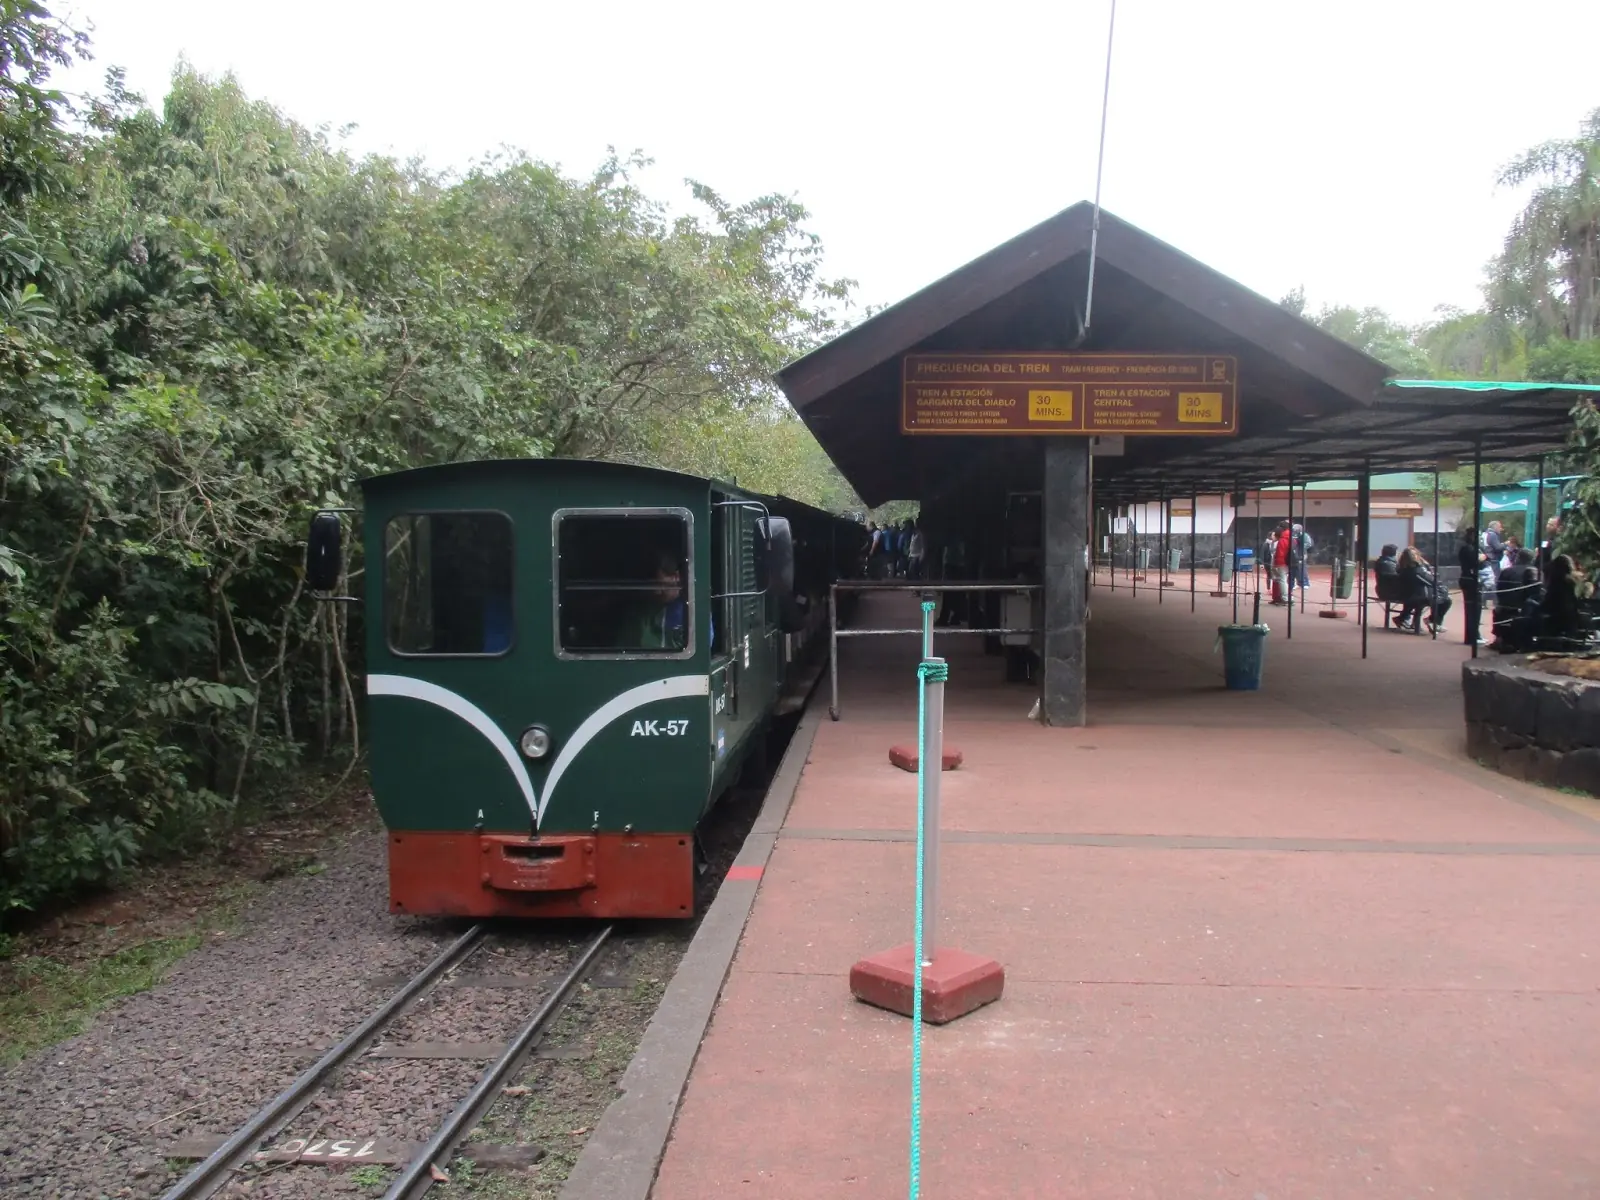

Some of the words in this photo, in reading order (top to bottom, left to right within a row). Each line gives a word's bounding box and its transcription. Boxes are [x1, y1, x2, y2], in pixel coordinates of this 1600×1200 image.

[917, 363, 991, 373] FRECUENCIA
[993, 363, 1015, 373] DEL
[1018, 363, 1050, 373] TREN
[917, 389, 940, 397] TREN
[941, 389, 948, 397] A
[950, 388, 993, 397] ESTACIÓN
[1094, 389, 1117, 397] TREN
[1119, 389, 1126, 397] A
[917, 398, 963, 407] GARGANTA
[965, 399, 981, 407] DEL
[984, 399, 1016, 407] DIABLO
[1036, 395, 1051, 405] 30
[1094, 398, 1133, 407] CENTRAL
[1186, 397, 1201, 407] 30
[1035, 407, 1065, 416] MINS.
[630, 719, 689, 737] AK-57
[477, 808, 484, 819] A
[593, 811, 600, 822] F
